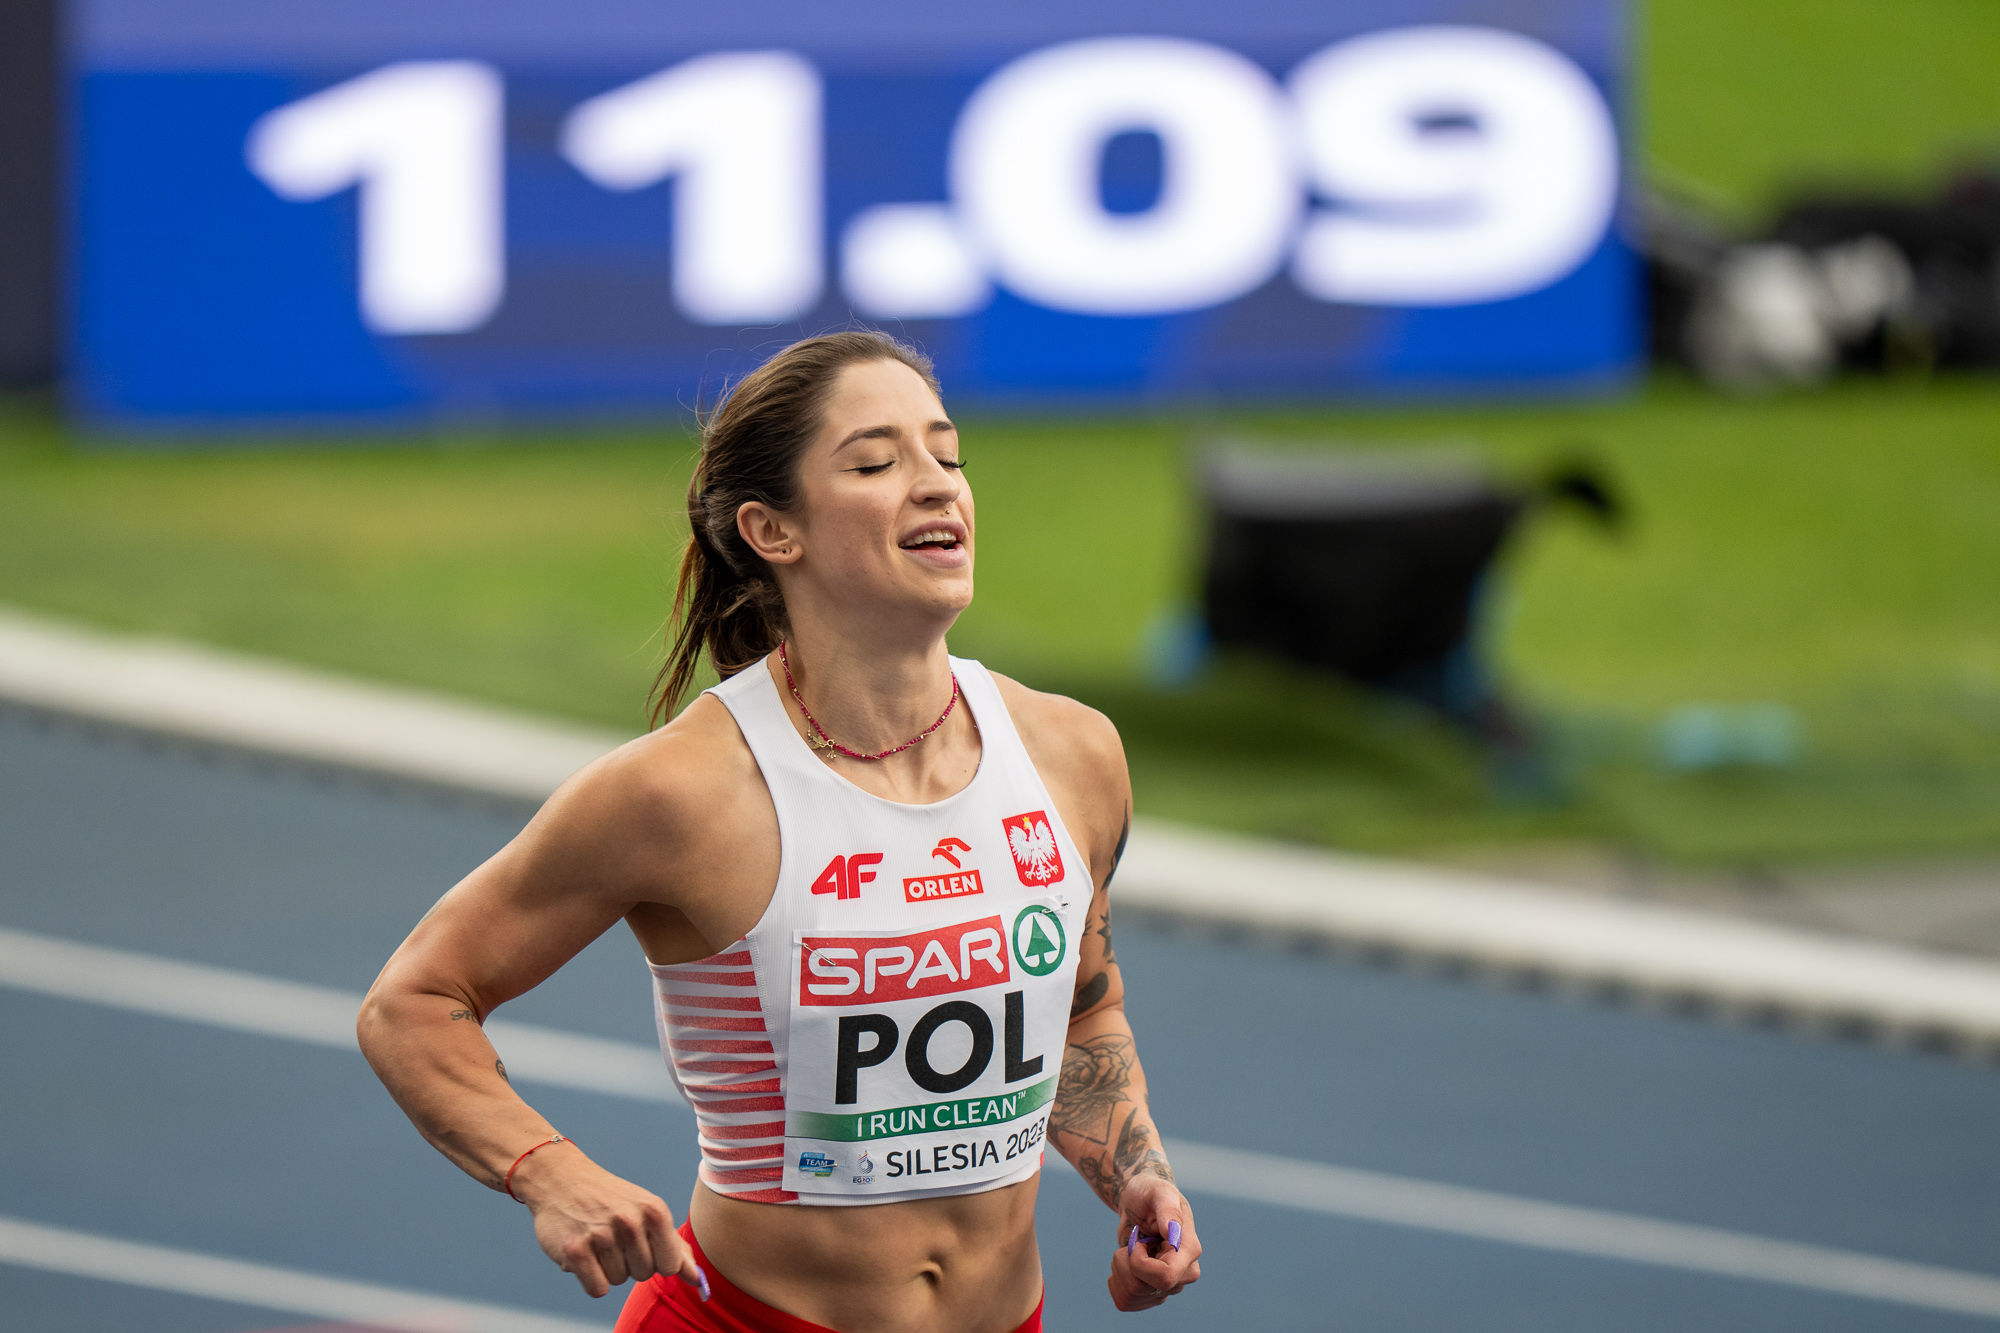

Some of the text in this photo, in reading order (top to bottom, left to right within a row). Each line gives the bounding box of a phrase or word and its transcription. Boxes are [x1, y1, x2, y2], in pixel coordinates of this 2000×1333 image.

[245, 25, 1618, 334] 11.09
[811, 852, 884, 900] 4F
[908, 873, 979, 899] ORLEN
[807, 927, 1004, 996] SPAR
[835, 990, 1044, 1104] POL
[857, 1116, 863, 1138] I
[870, 1108, 926, 1136] RUN
[806, 1158, 828, 1167] TEAM
[886, 1140, 999, 1177] SILESIA
